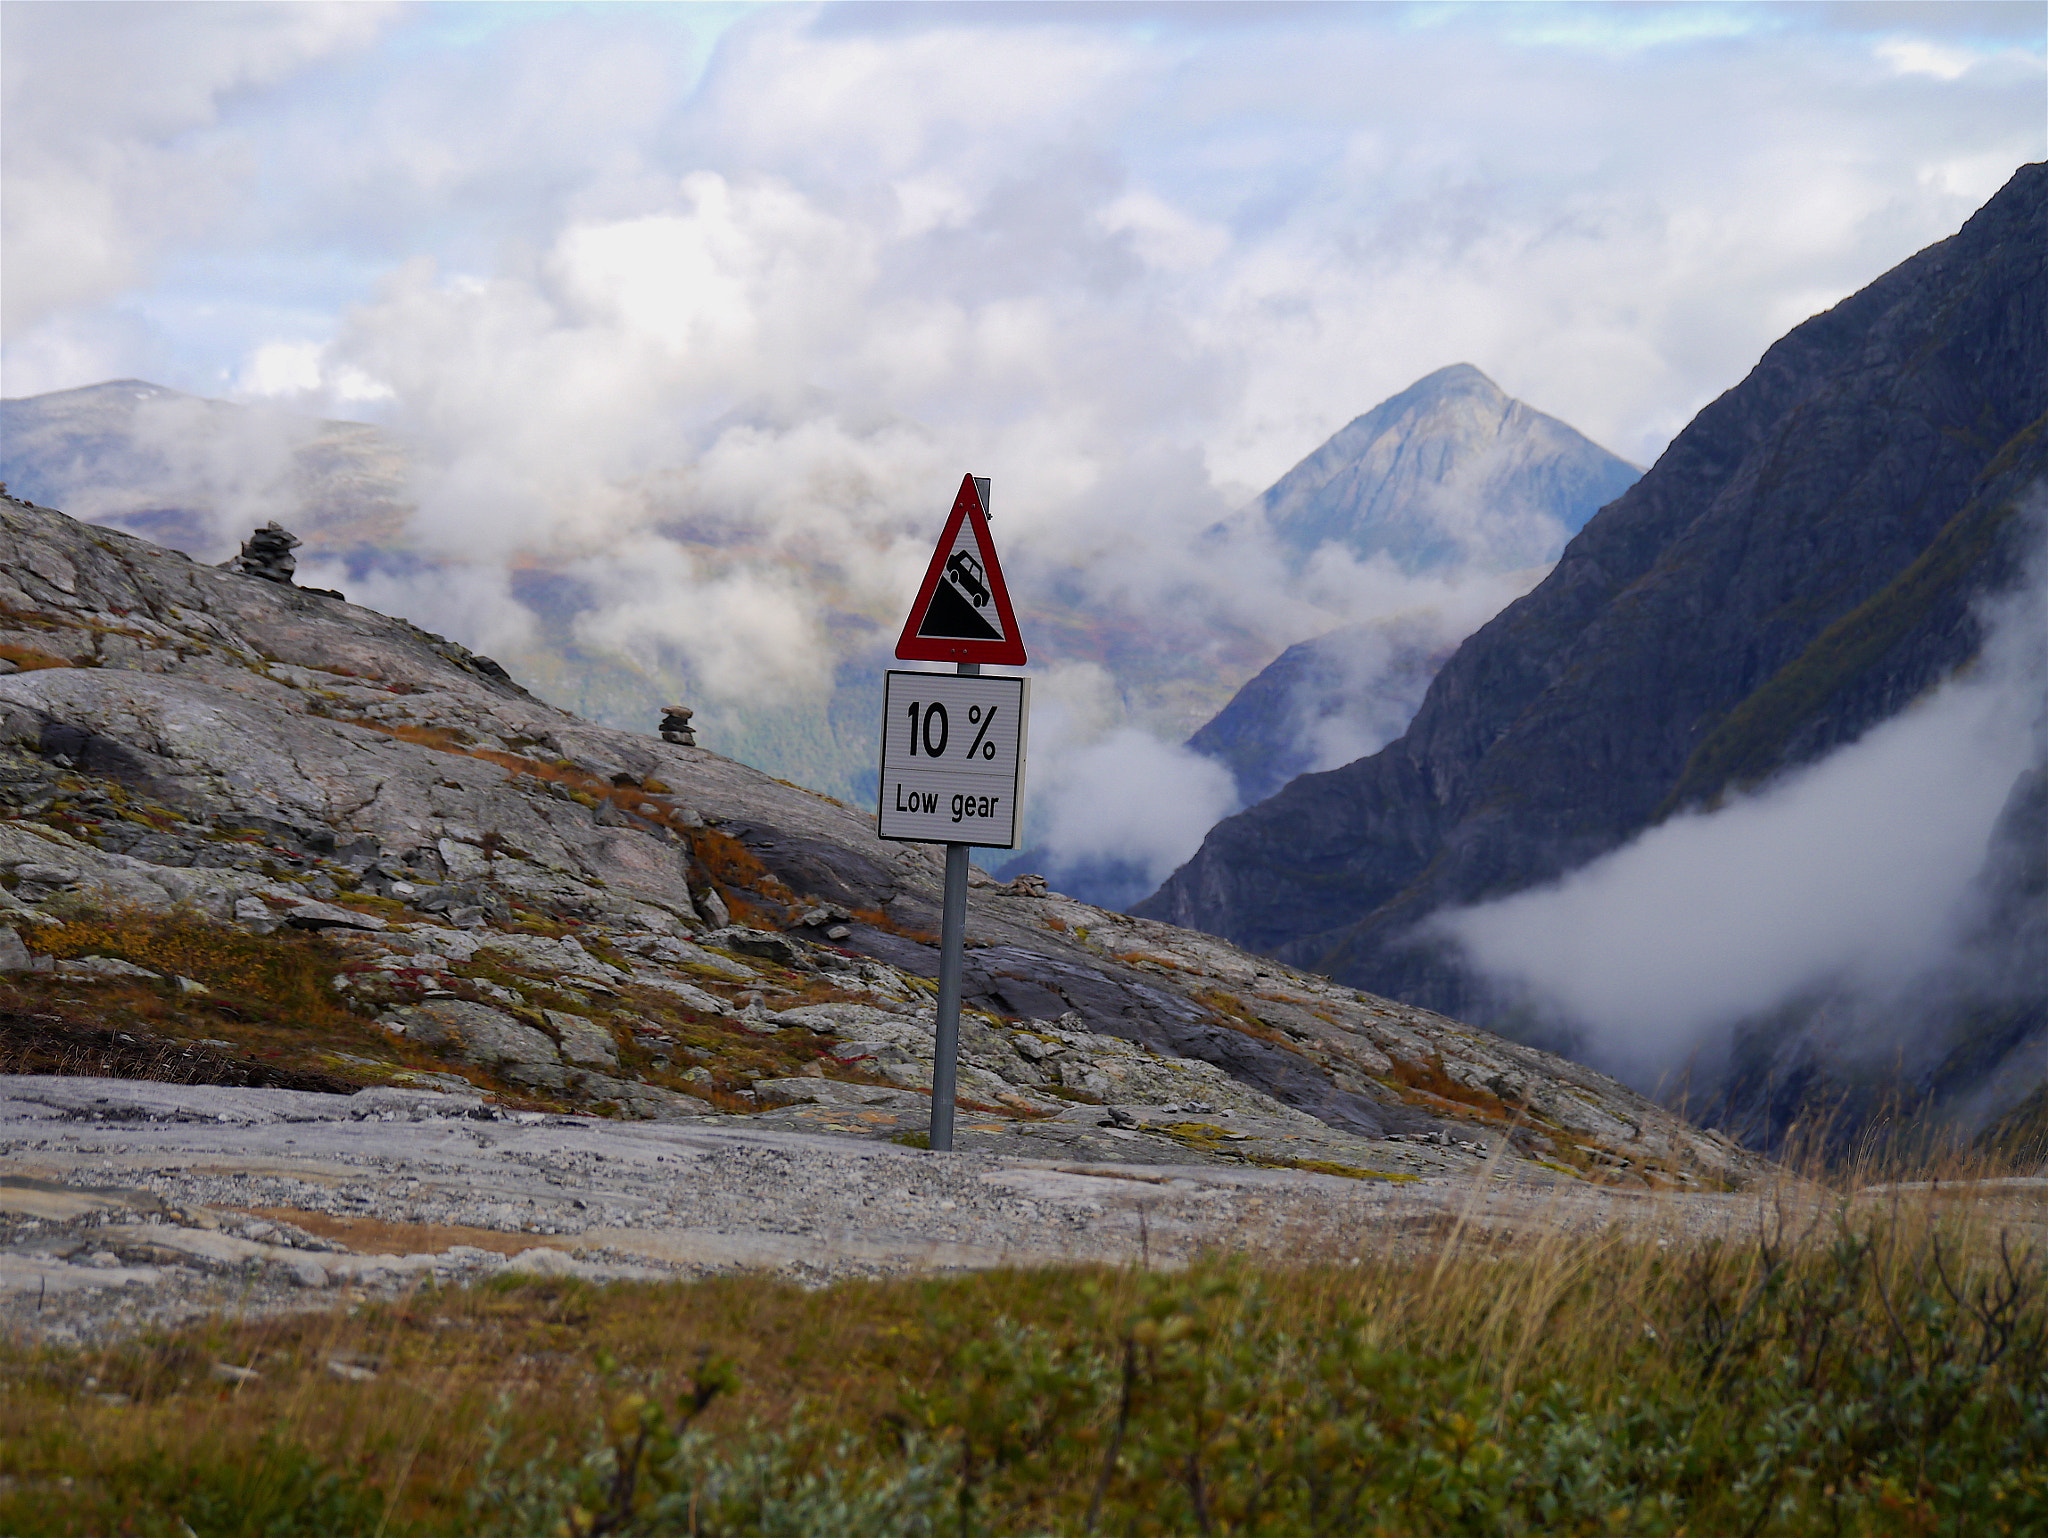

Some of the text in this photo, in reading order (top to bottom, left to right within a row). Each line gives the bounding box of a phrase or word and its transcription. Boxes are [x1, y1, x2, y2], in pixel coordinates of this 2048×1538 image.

[907, 701, 998, 760] 10 %
[896, 783, 999, 823] Low gear
